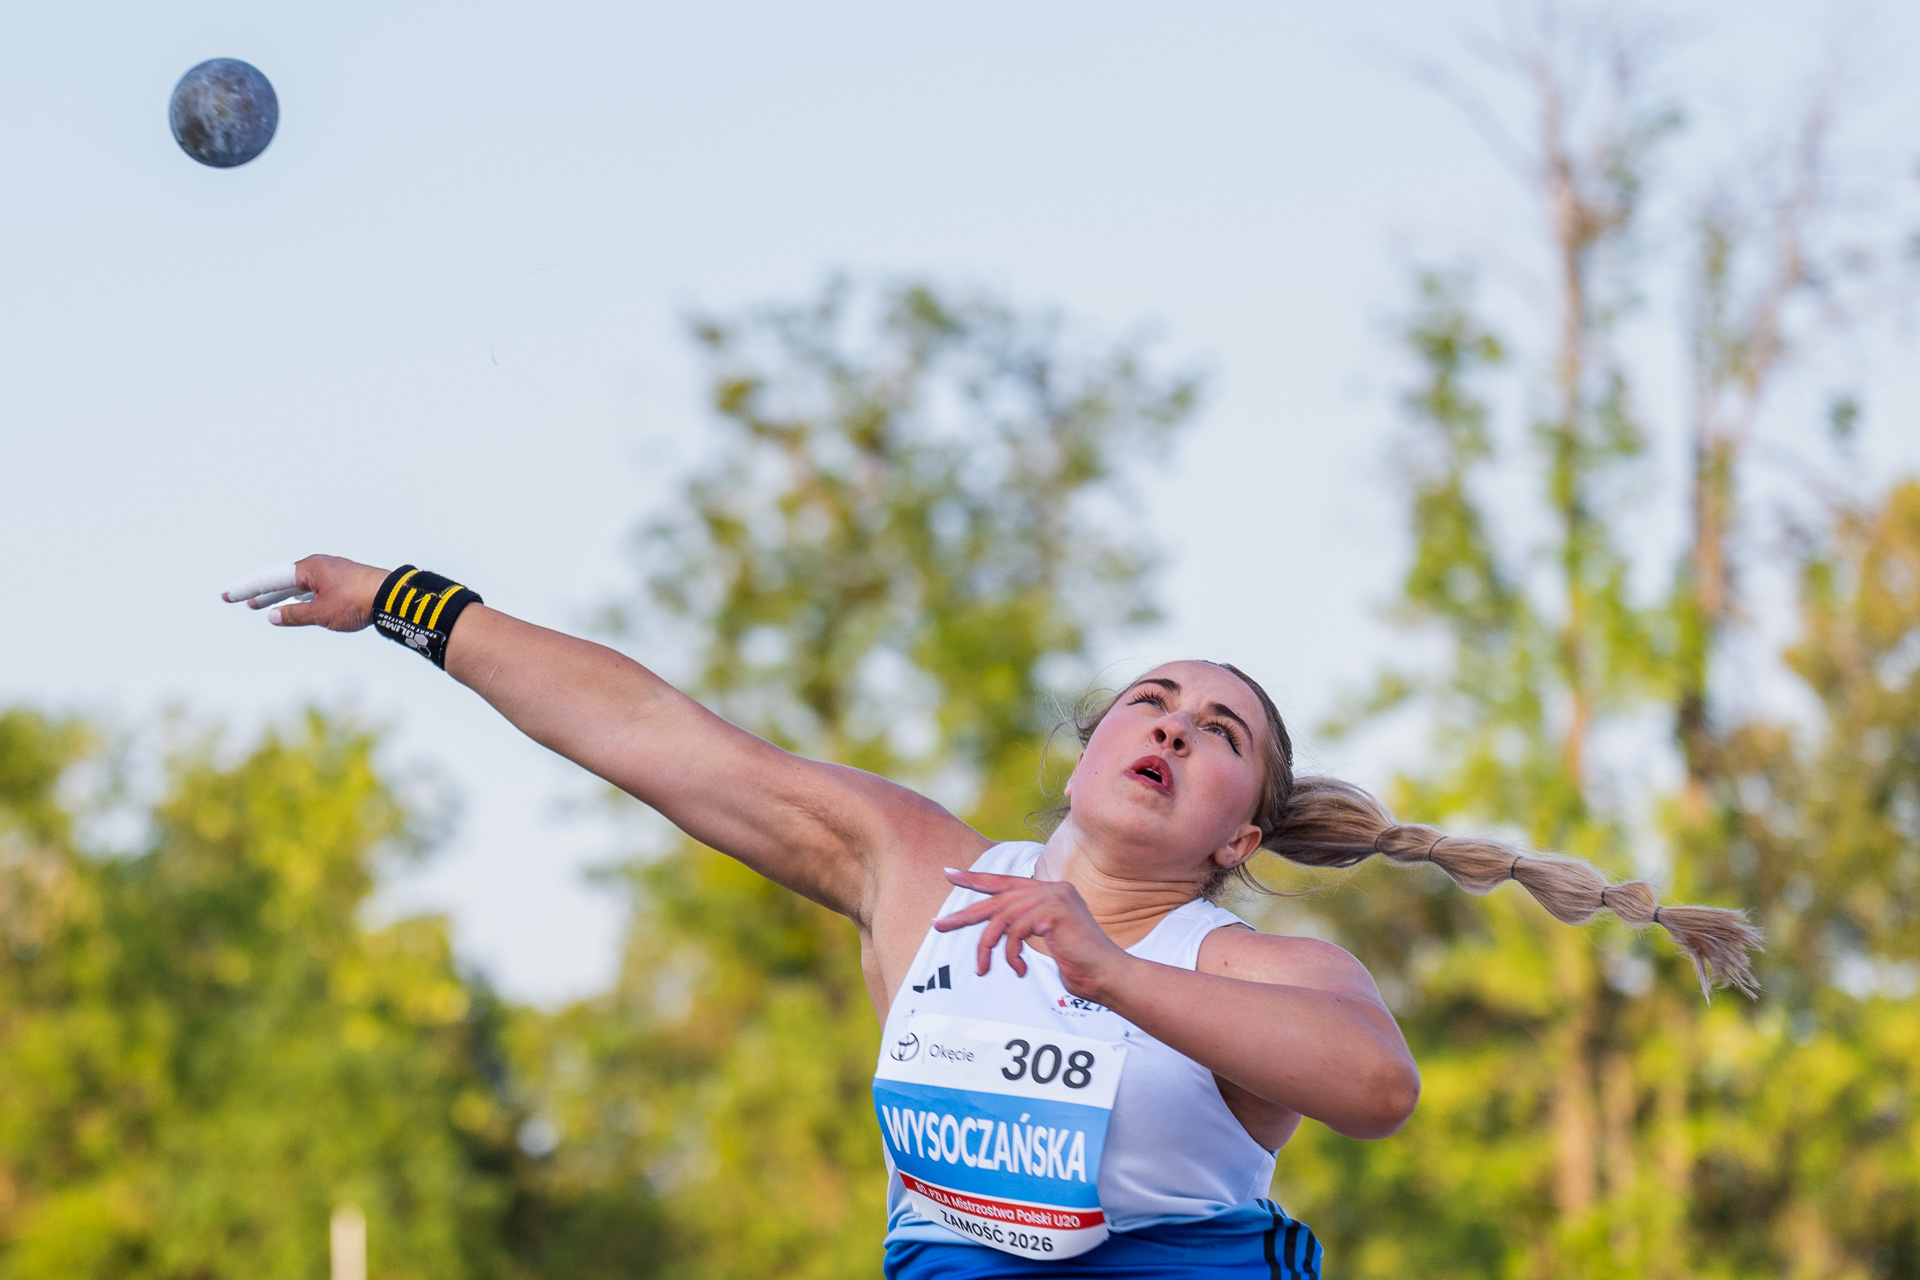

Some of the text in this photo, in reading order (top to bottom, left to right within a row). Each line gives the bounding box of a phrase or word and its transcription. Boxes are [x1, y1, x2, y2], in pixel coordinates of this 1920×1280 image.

[377, 619, 415, 639] OLIMP
[378, 613, 438, 639] SPORT NUTRITION
[929, 1043, 975, 1063] Okęcie
[1001, 1039, 1095, 1089] 308
[881, 1104, 1087, 1183] WYSOCZAŃSKA
[929, 1189, 952, 1206] PZLA
[951, 1197, 1015, 1221] Mistrzostwa
[1016, 1209, 1052, 1226] Polski
[1053, 1213, 1080, 1228] U20
[940, 1209, 1054, 1252] ZAMOŚĆ 2026
